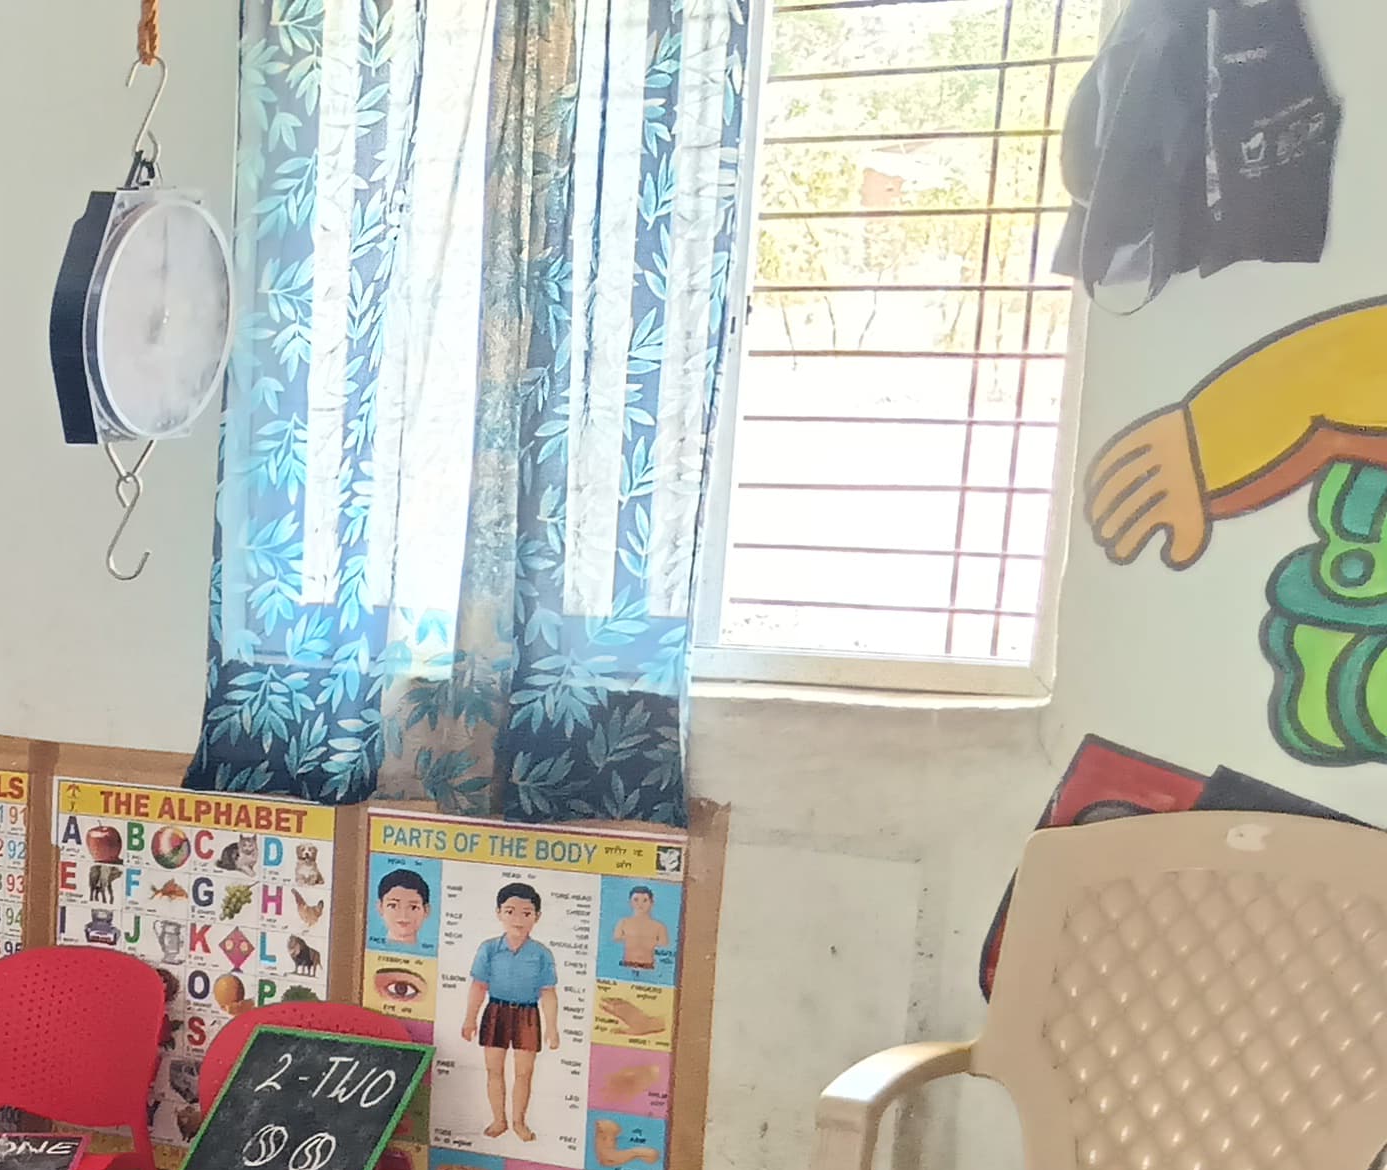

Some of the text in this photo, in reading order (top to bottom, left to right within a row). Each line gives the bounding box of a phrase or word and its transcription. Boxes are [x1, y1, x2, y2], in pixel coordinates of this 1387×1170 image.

[10, 806, 27, 826] 91
[100, 790, 308, 834] THE ALPHABET
[8, 840, 26, 859] 92
[62, 815, 284, 867] A B C D
[383, 824, 598, 865] PARTS OF THE BODY
[7, 874, 25, 893] 93
[59, 862, 283, 915] E F G H
[125, 916, 140, 943] J
[189, 923, 211, 954] K
[259, 932, 276, 963] L
[187, 970, 276, 1007] O P
[187, 1016, 206, 1046] S
